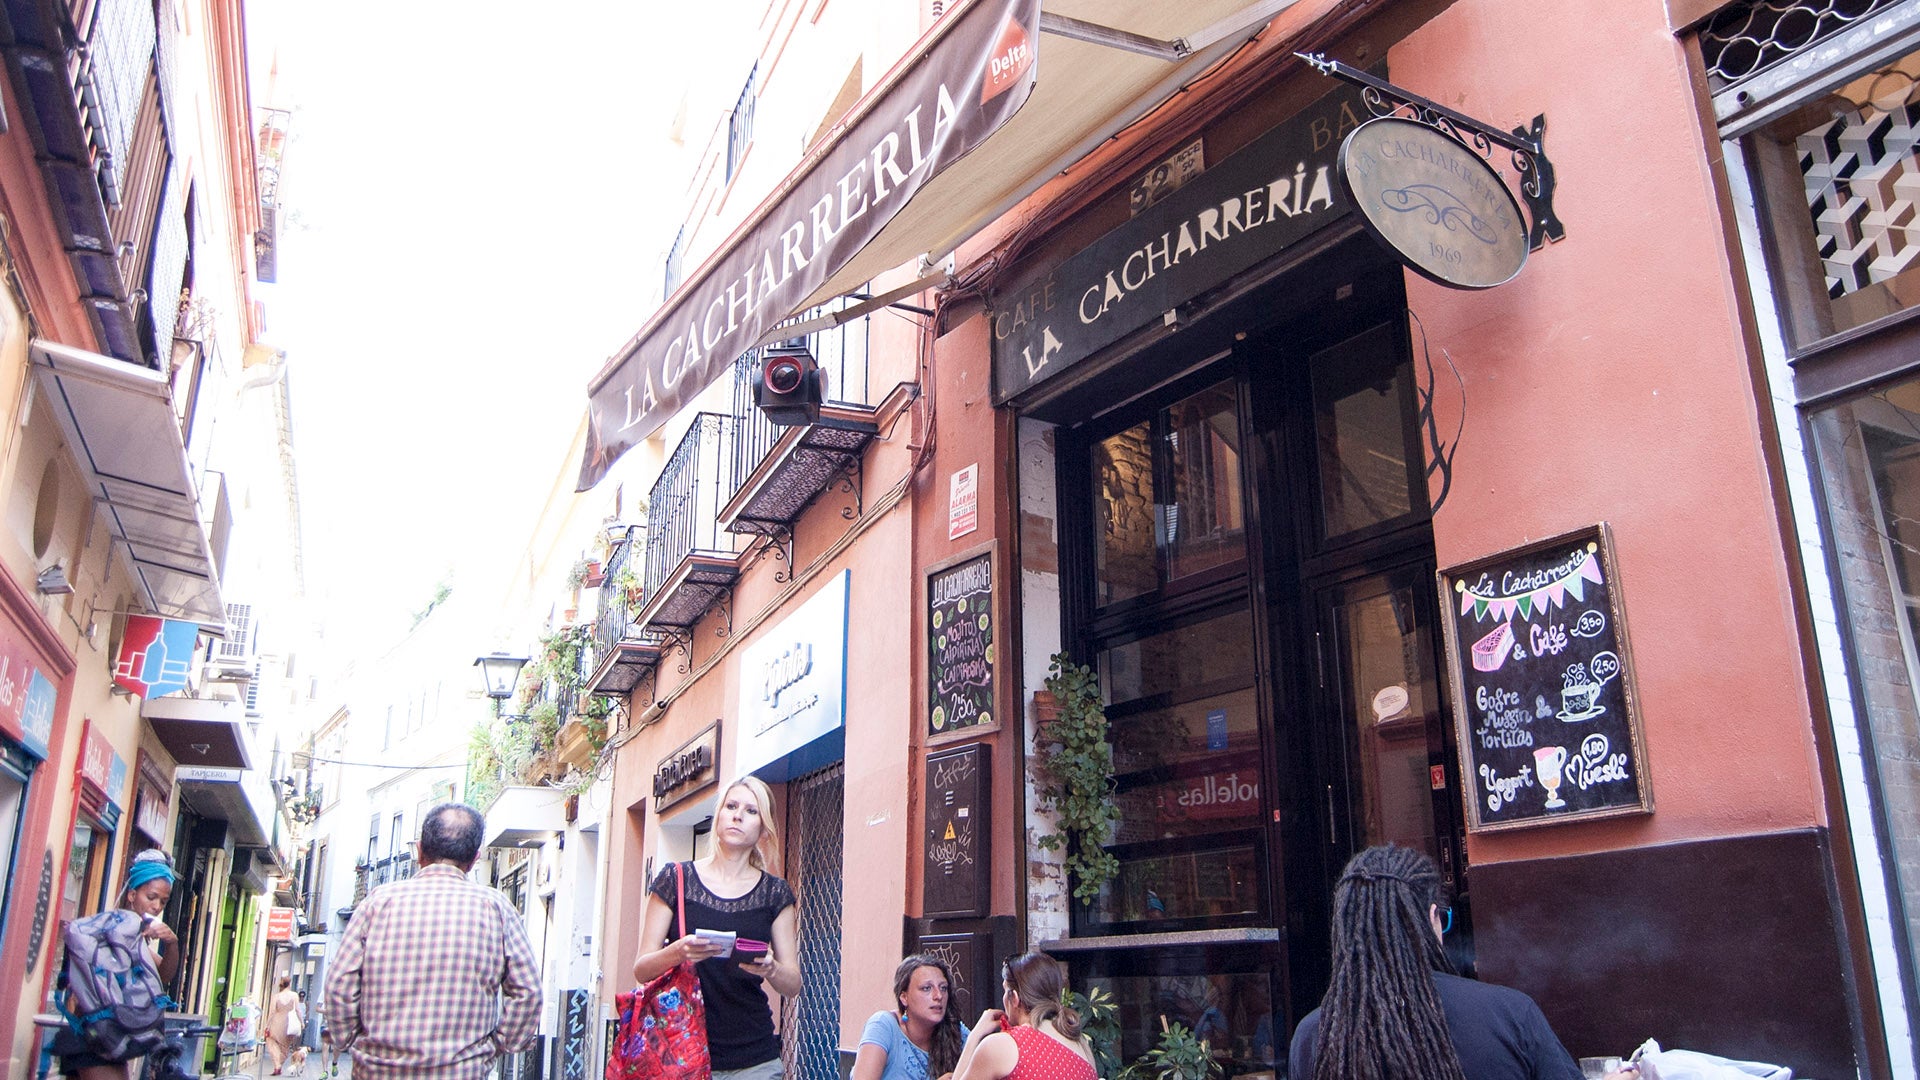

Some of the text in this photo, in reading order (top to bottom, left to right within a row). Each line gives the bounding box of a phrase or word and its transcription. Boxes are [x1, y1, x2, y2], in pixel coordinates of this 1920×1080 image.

[991, 44, 1027, 77] Delta
[617, 83, 956, 433] LA CACHARRERIA
[1429, 241, 1463, 265] 1969
[1022, 325, 1063, 380] LA
[934, 578, 944, 603] LA
[1469, 572, 1495, 597] La
[1529, 622, 1569, 657] Café
[1594, 658, 1617, 675] 2,50
[1475, 685, 1521, 713] Gofre
[1483, 707, 1533, 730] Muffin
